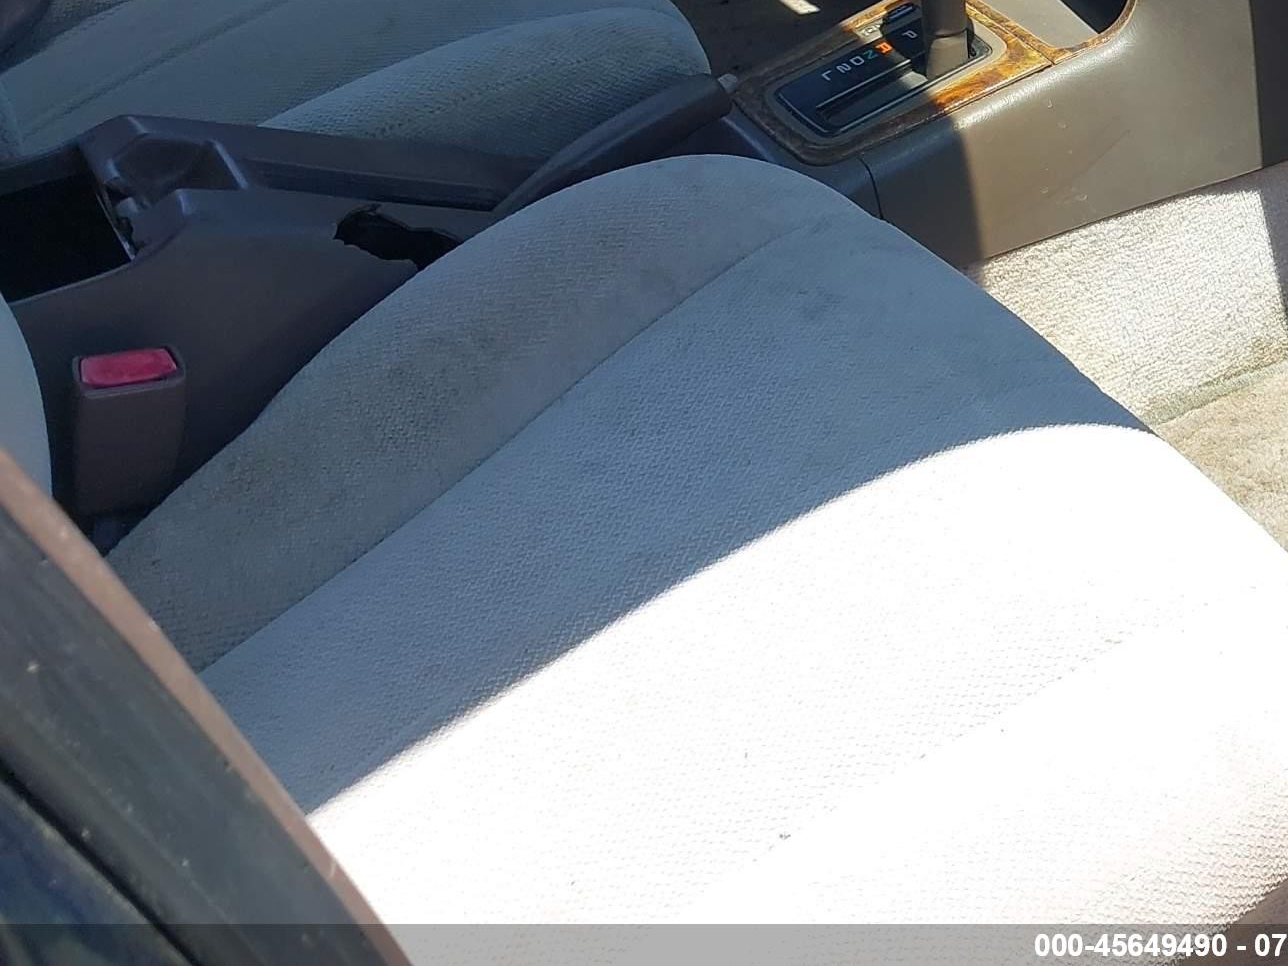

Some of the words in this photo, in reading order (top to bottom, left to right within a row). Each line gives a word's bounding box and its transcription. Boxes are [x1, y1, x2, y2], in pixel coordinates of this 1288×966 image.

[902, 30, 917, 38] P
[875, 42, 893, 53] R
[863, 49, 877, 59] N
[836, 63, 852, 73] 2
[821, 69, 832, 81] L
